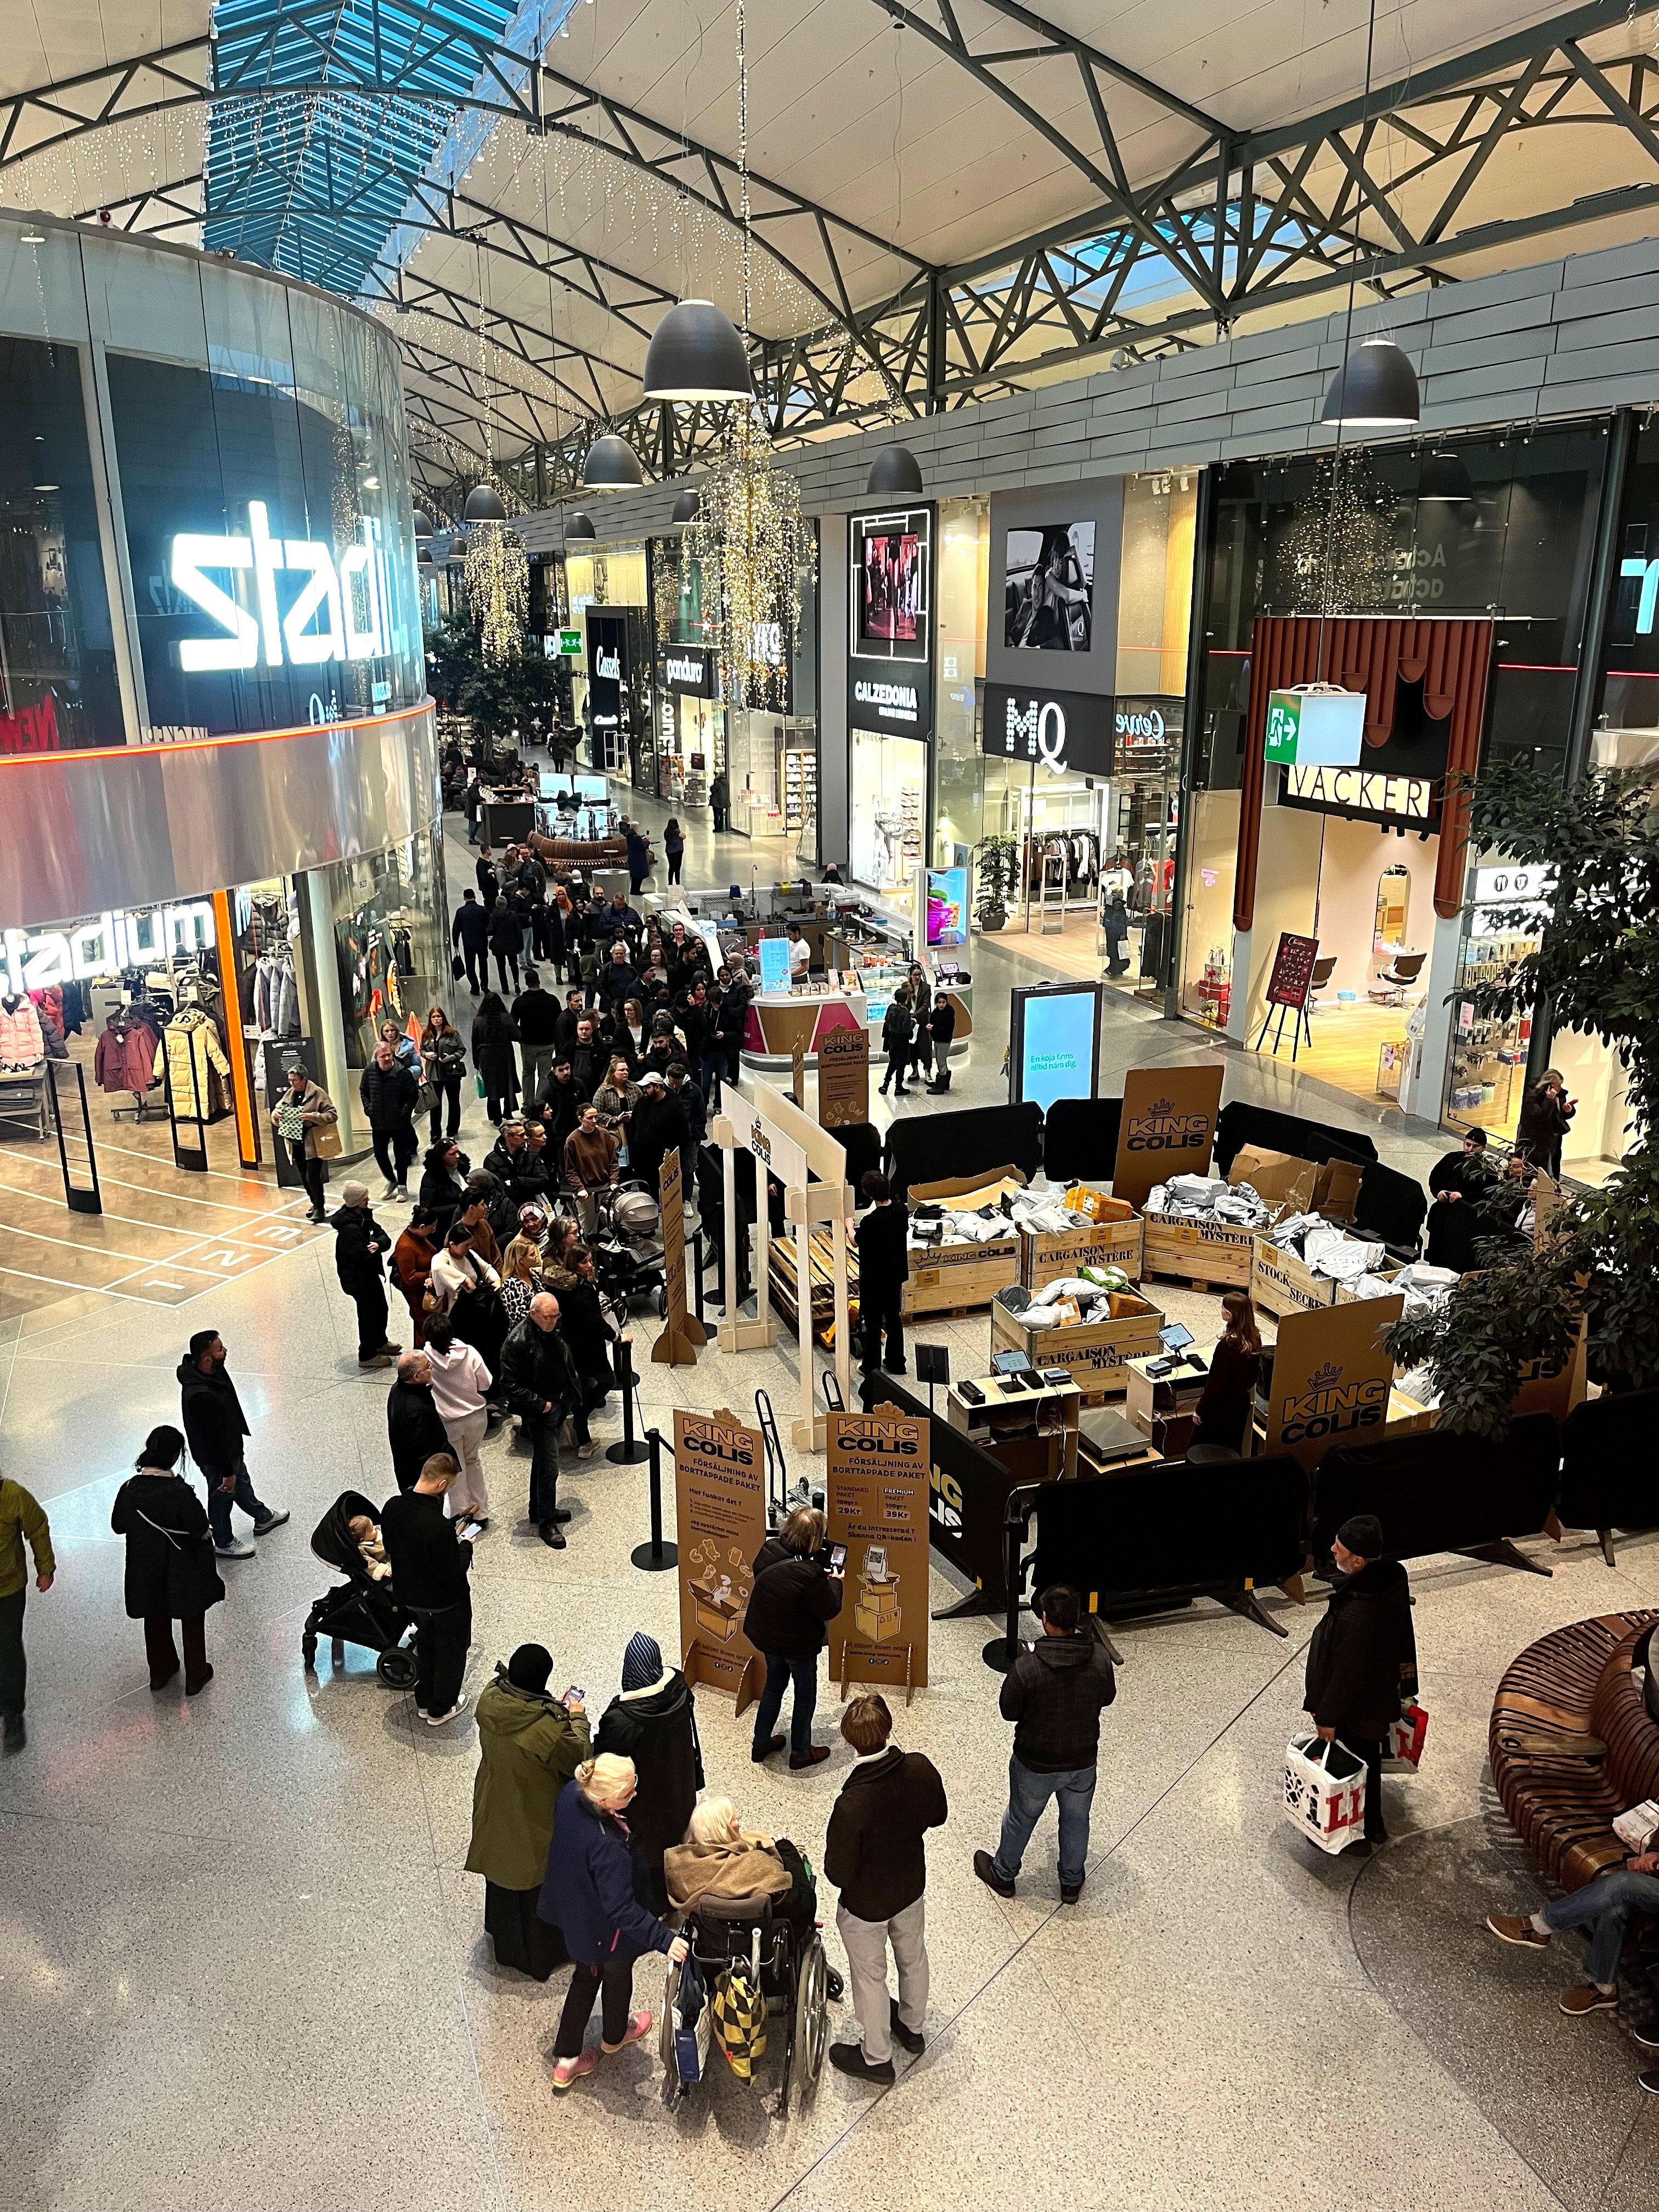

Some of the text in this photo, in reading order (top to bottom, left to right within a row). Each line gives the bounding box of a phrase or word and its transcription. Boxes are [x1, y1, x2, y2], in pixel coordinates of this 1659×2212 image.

[667, 654, 703, 684] panduro
[855, 681, 917, 708] CALZEDONIA
[1006, 697, 1067, 775] MQ
[1288, 765, 1431, 818] VACKER
[0, 900, 216, 995] tadium
[823, 1033, 864, 1046] KING
[823, 1043, 864, 1054] COLIS
[1031, 1063, 1047, 1071] alltid
[1041, 1054, 1056, 1063] koja
[1128, 1115, 1209, 1136] KING
[751, 1124, 771, 1154] KING
[1127, 1133, 1205, 1151] COLIS
[752, 1140, 771, 1166] COLIS
[1150, 1214, 1223, 1232] CARGAISON
[943, 1246, 1015, 1263] KING COLIS
[1039, 1244, 1105, 1263] CARGAISON
[1084, 1249, 1133, 1267] MYSTÈRE
[1258, 1261, 1291, 1288] STOCK
[1290, 1287, 1328, 1310] SECRE
[1037, 1345, 1116, 1366] CARGAISON
[1282, 1378, 1386, 1424] KING
[683, 1418, 754, 1451] KING
[837, 1419, 919, 1441] KING
[1280, 1405, 1381, 1444] COLIS
[683, 1436, 753, 1465] COLIS
[837, 1436, 918, 1455] COLIS
[693, 1457, 759, 1481] FÖRSÄLJNING AV
[832, 1466, 926, 1479] BORTTAPPADE PAKET
[849, 1457, 910, 1469] FÖRSÄLJNING
[679, 1464, 760, 1492] BORTTAPPADE PAKET
[929, 1463, 962, 1513] NG
[689, 1487, 701, 1496] Hur
[702, 1491, 725, 1502] funkar
[726, 1497, 737, 1505] det
[838, 1507, 861, 1515] 29Kr
[886, 1510, 909, 1519] 39Kr
[868, 1525, 910, 1534] intresserad
[876, 1534, 912, 1542] QR-koden
